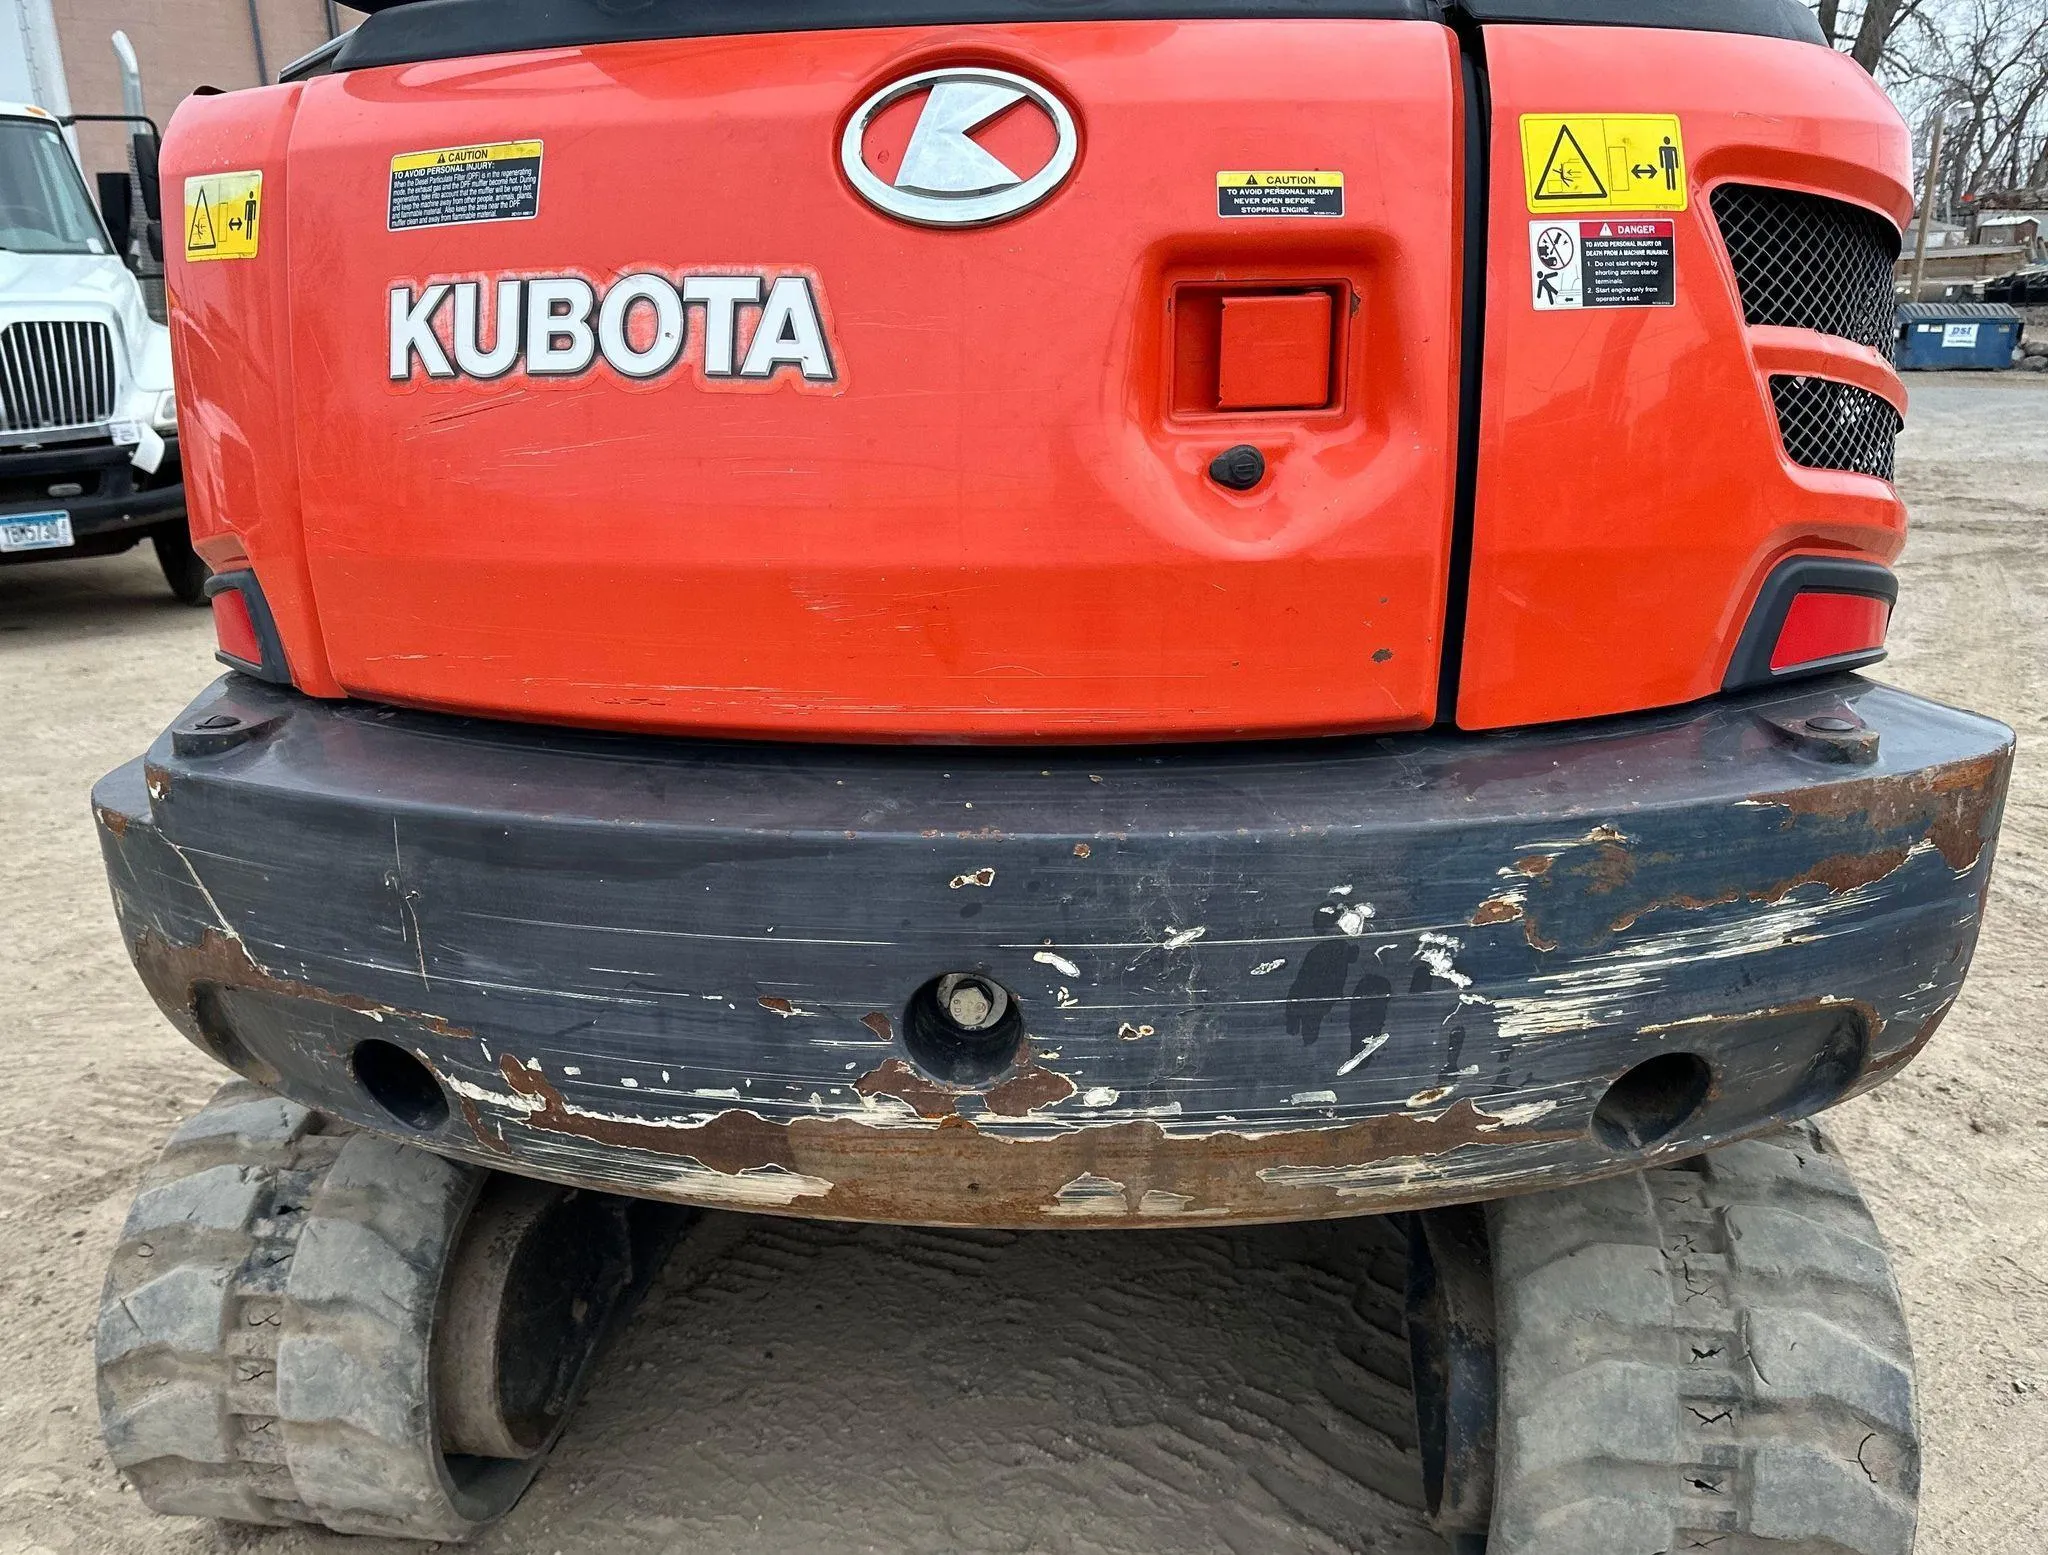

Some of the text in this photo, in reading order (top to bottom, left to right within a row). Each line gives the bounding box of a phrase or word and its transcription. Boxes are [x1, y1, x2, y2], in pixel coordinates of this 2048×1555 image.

[448, 149, 488, 163] CAUTION
[394, 161, 496, 180] TO AVOID PERSONAL INJURY:
[1266, 176, 1316, 184] CAUTION
[1617, 225, 1656, 234] DANGER
[1609, 240, 1636, 248] PERSONAL
[1630, 260, 1649, 268] engine
[1650, 260, 1658, 268] by
[1595, 269, 1619, 277] shorting
[1631, 286, 1644, 294] only
[1595, 295, 1625, 303] operator's
[388, 273, 834, 380] KUBOTA
